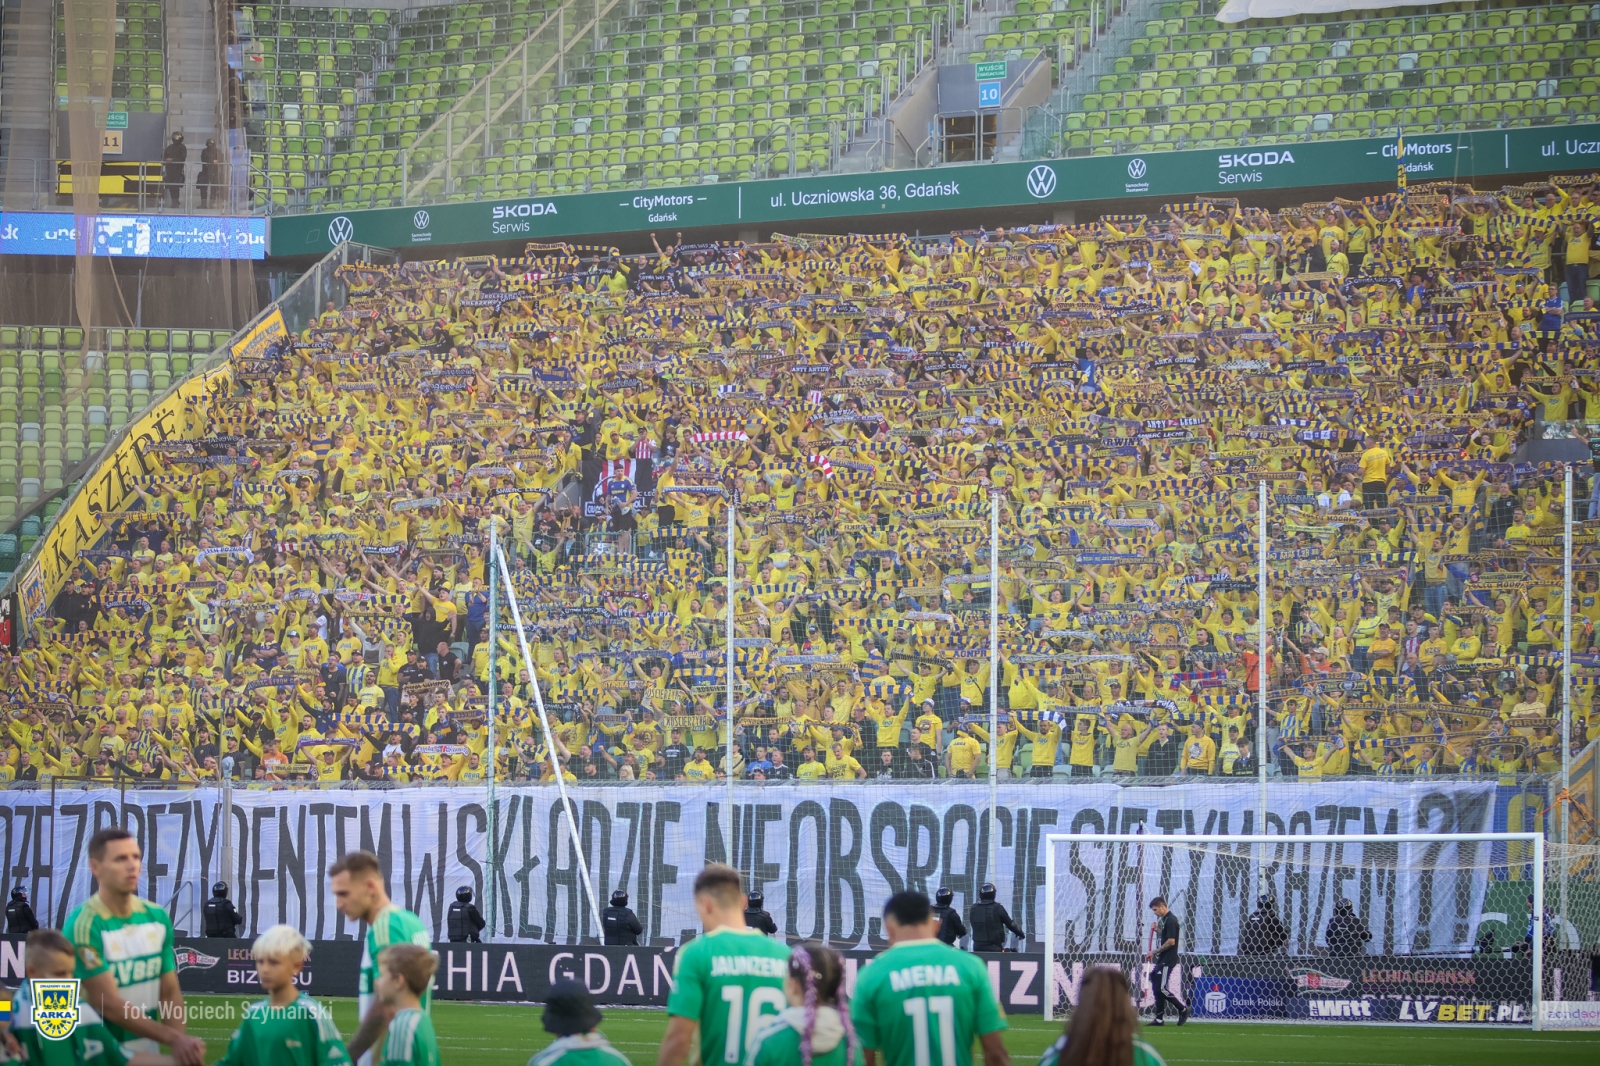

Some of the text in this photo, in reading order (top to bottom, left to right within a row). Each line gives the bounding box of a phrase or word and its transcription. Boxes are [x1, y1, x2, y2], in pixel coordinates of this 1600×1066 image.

[981, 88, 998, 100] 10
[103, 136, 119, 147] 11
[1541, 141, 1560, 157] ul.
[1218, 169, 1263, 185] Serwis
[770, 180, 960, 207] ul. Uczniowska 36, Gdańsk
[633, 195, 693, 211] CityMotors
[648, 211, 678, 223] Gdańsk
[492, 219, 550, 234] Serwis
[402, 801, 448, 943] W
[1264, 804, 1399, 956] RAZEM
[889, 963, 961, 993] MENA
[1361, 968, 1411, 984] LECHIA
[1232, 997, 1283, 1007] Bank Polski
[1317, 1000, 1372, 1018] Witt
[902, 995, 957, 1066] 11
